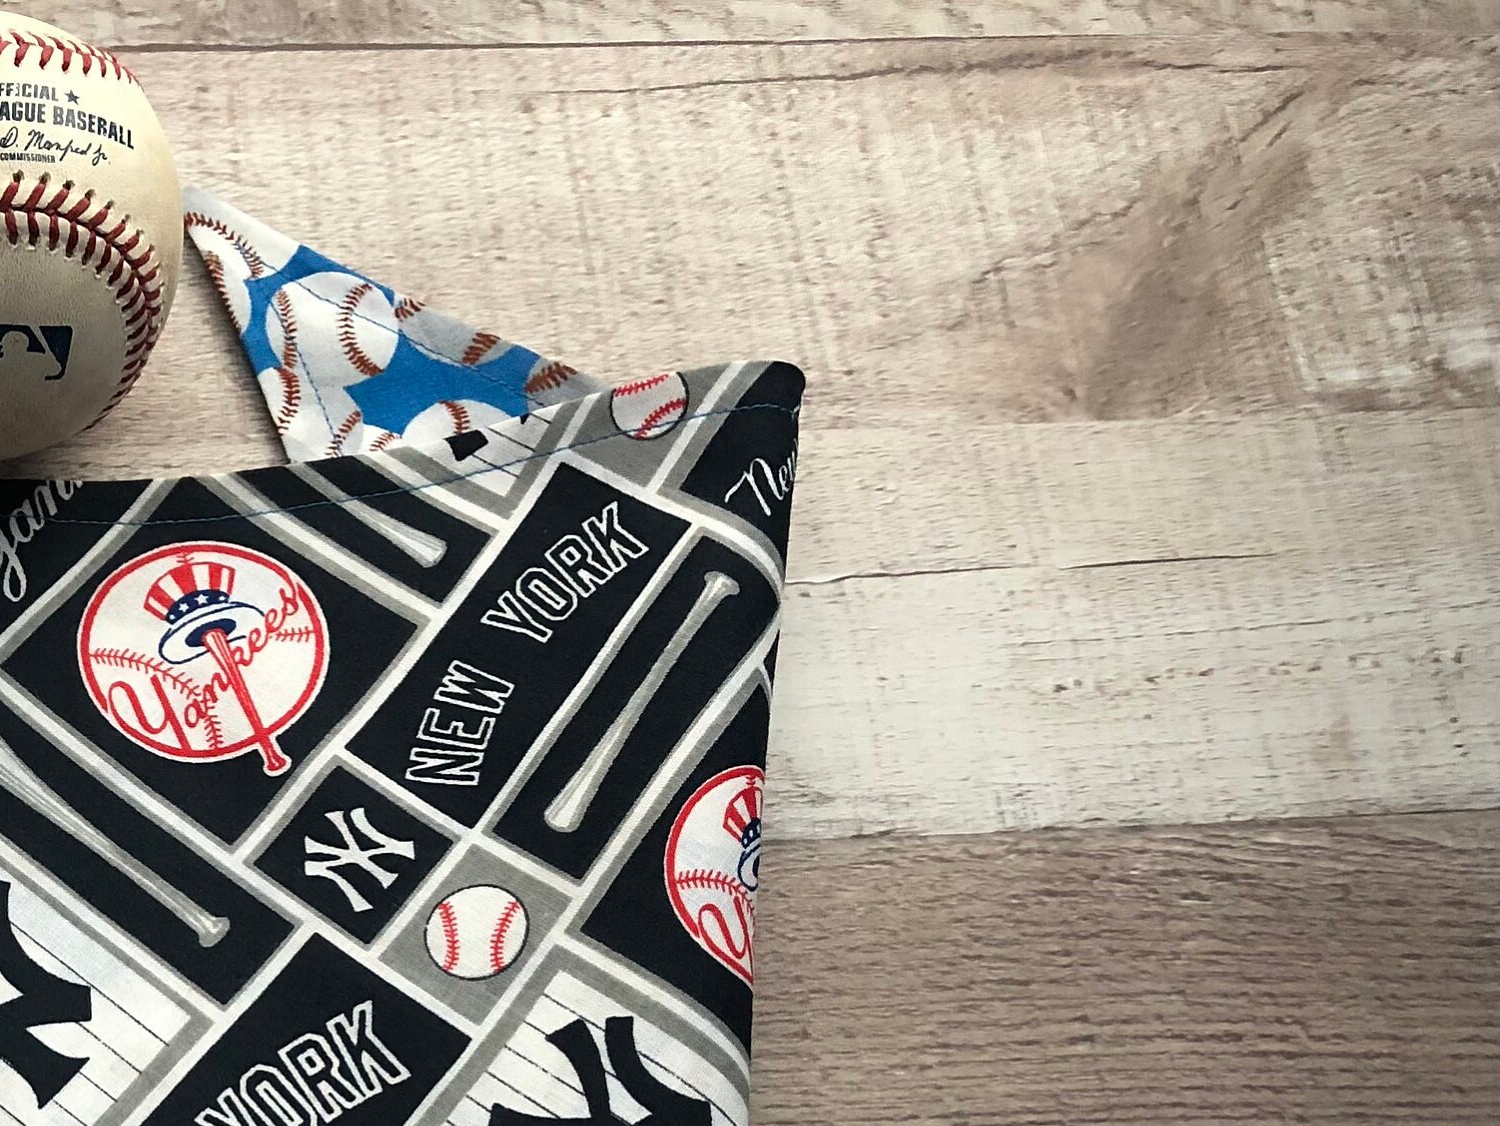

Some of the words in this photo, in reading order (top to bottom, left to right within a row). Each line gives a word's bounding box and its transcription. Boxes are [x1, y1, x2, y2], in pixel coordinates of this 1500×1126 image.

[0, 152, 56, 164] COMMISSIONER
[52, 105, 135, 150] BASEBALL
[104, 583, 300, 752] Yankees
[404, 660, 516, 787] NEW
[481, 501, 649, 643] YORK
